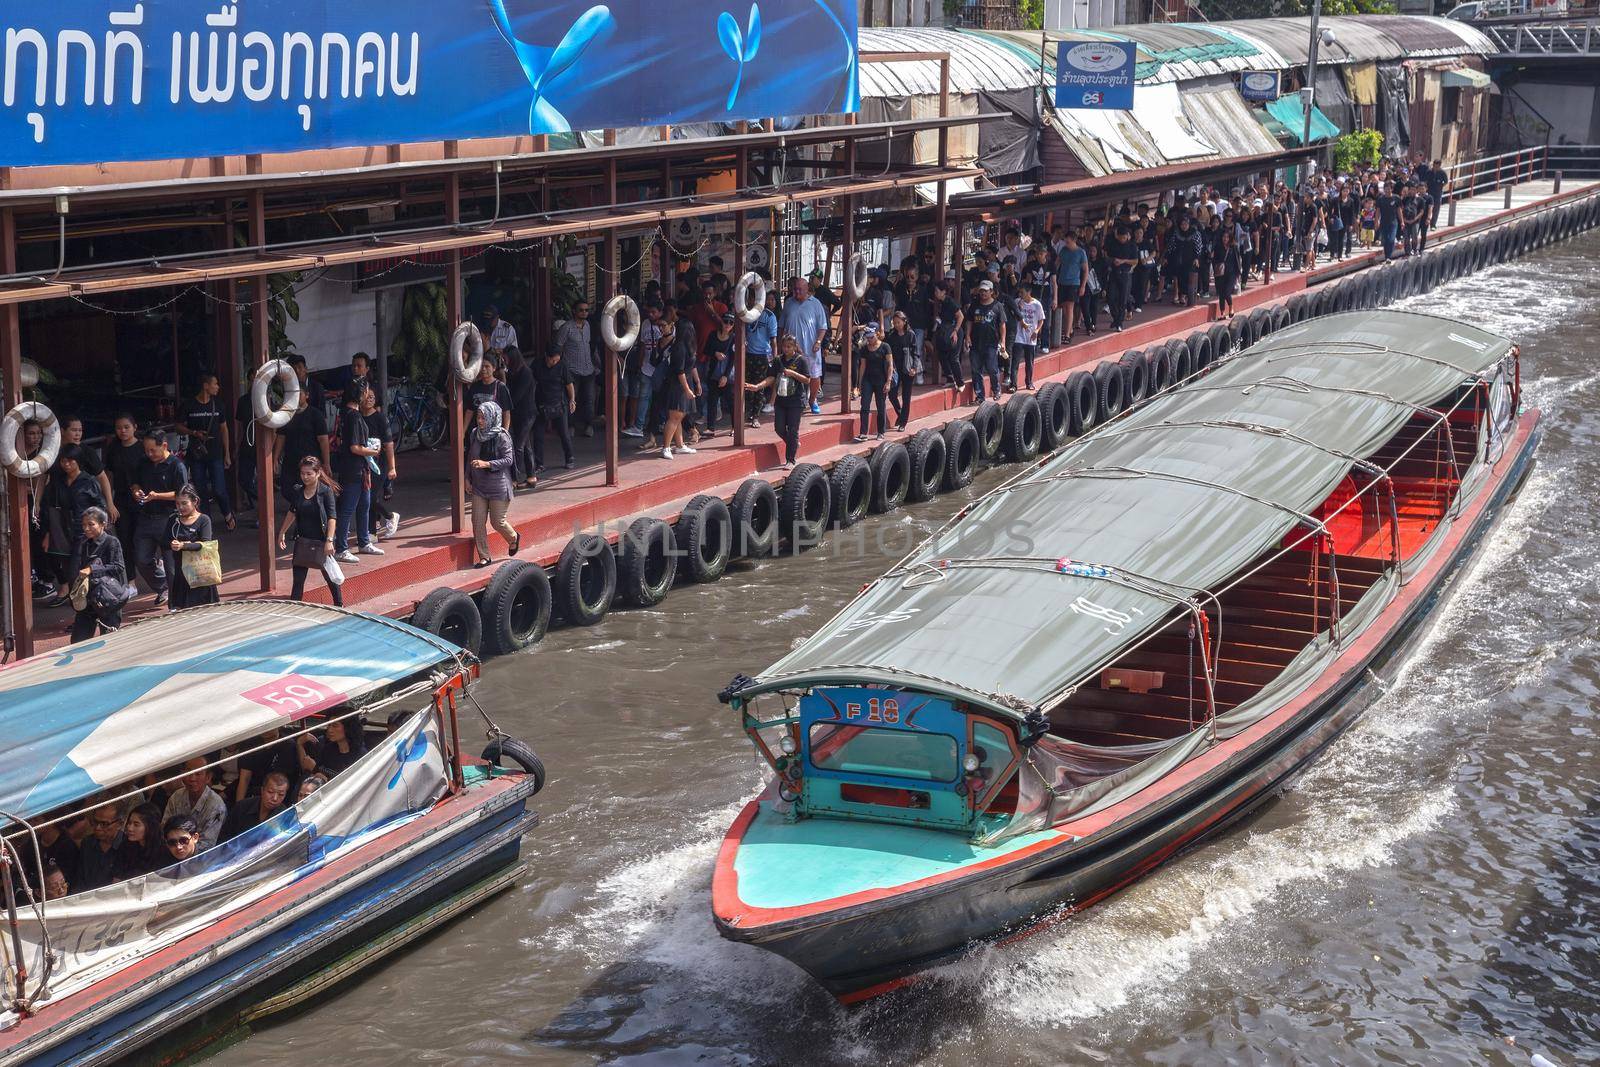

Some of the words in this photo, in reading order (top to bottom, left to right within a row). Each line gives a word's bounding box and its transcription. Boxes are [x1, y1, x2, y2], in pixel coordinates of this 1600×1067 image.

[262, 684, 326, 712] 59
[846, 702, 861, 719] F
[867, 697, 899, 723] 18
